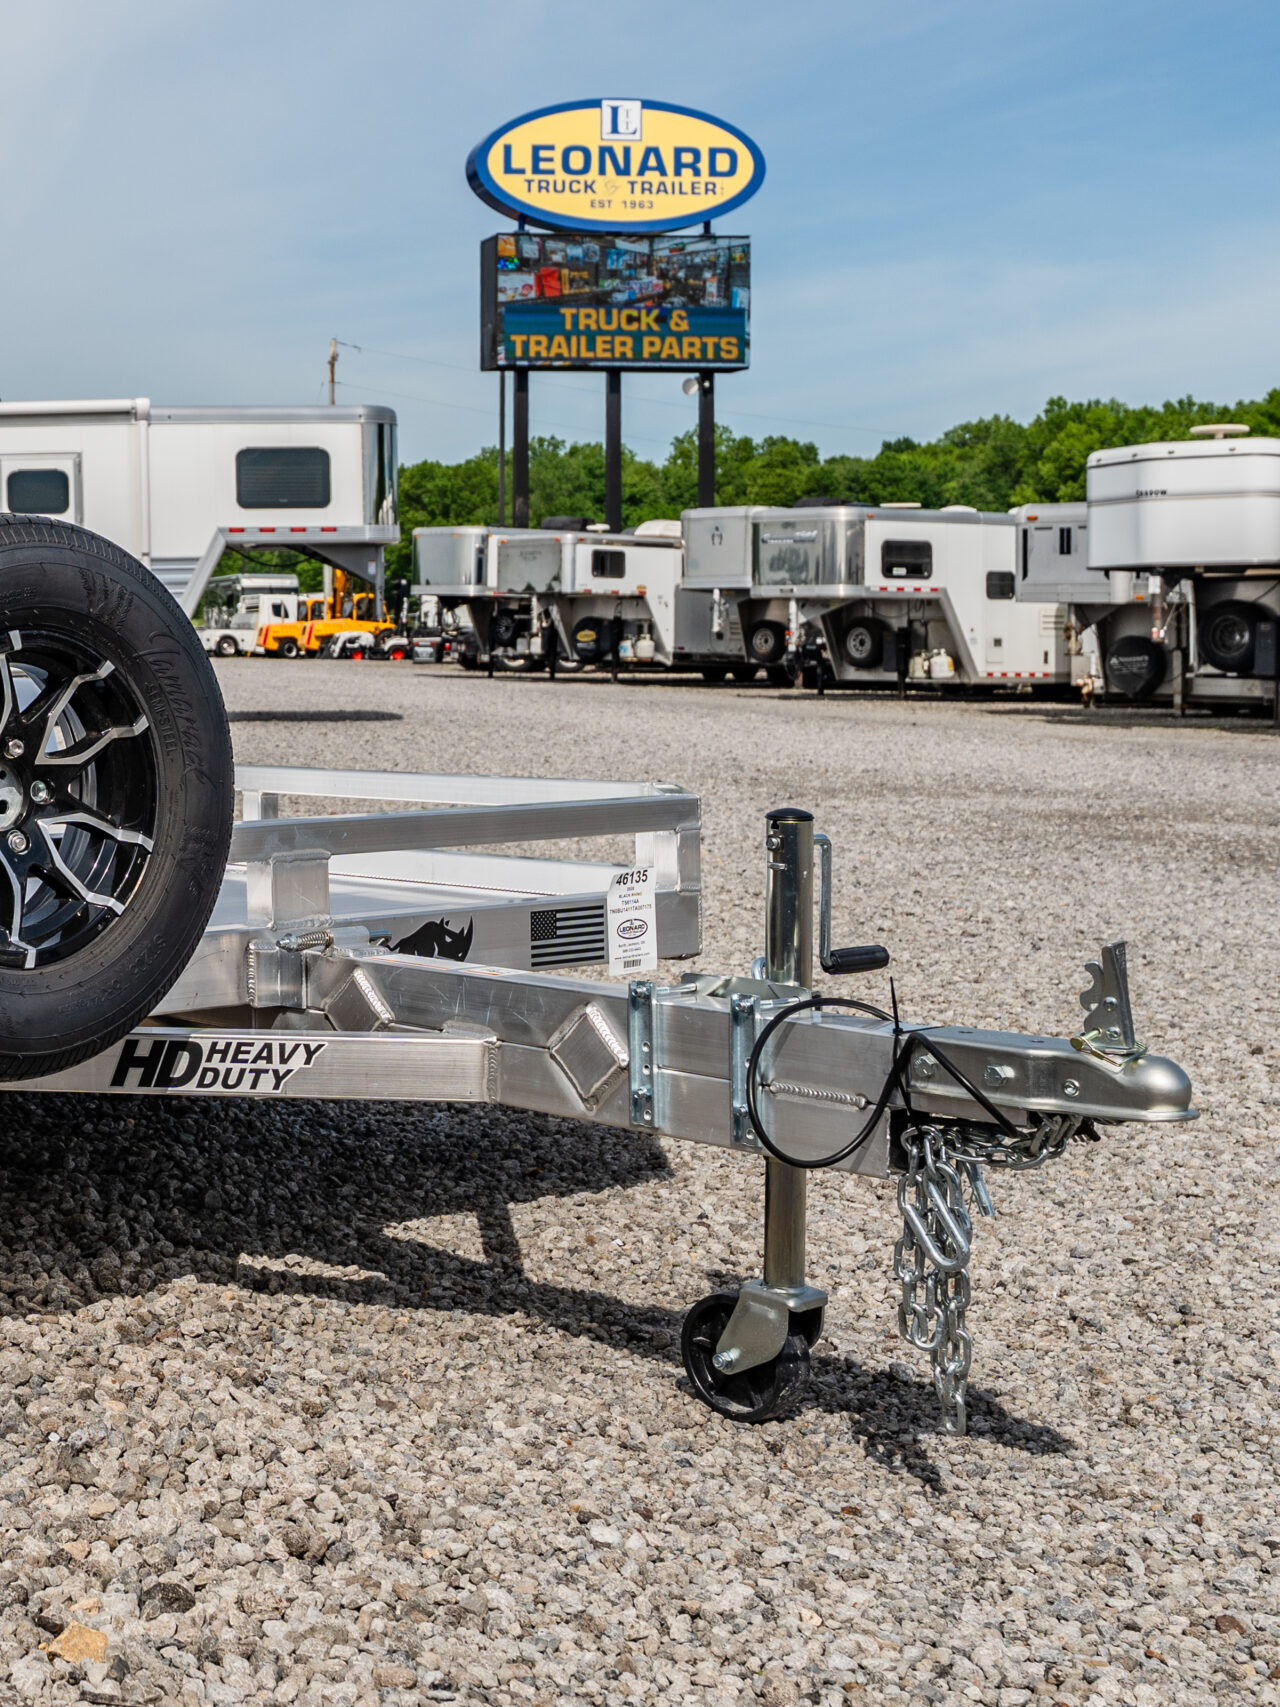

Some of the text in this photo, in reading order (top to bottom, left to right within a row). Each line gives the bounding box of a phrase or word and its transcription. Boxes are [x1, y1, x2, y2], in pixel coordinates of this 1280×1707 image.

[503, 144, 738, 178] LEONARD
[524, 179, 597, 194] TRUCK
[628, 181, 717, 196] TRAILER
[590, 199, 654, 210] EST 1963
[560, 307, 690, 332] TRUCK &
[510, 334, 739, 360] TRAILER PARTS
[616, 869, 648, 886] 46135
[110, 1039, 203, 1088] HD
[205, 1041, 327, 1066] HEAVY
[196, 1066, 296, 1091] DUTY
